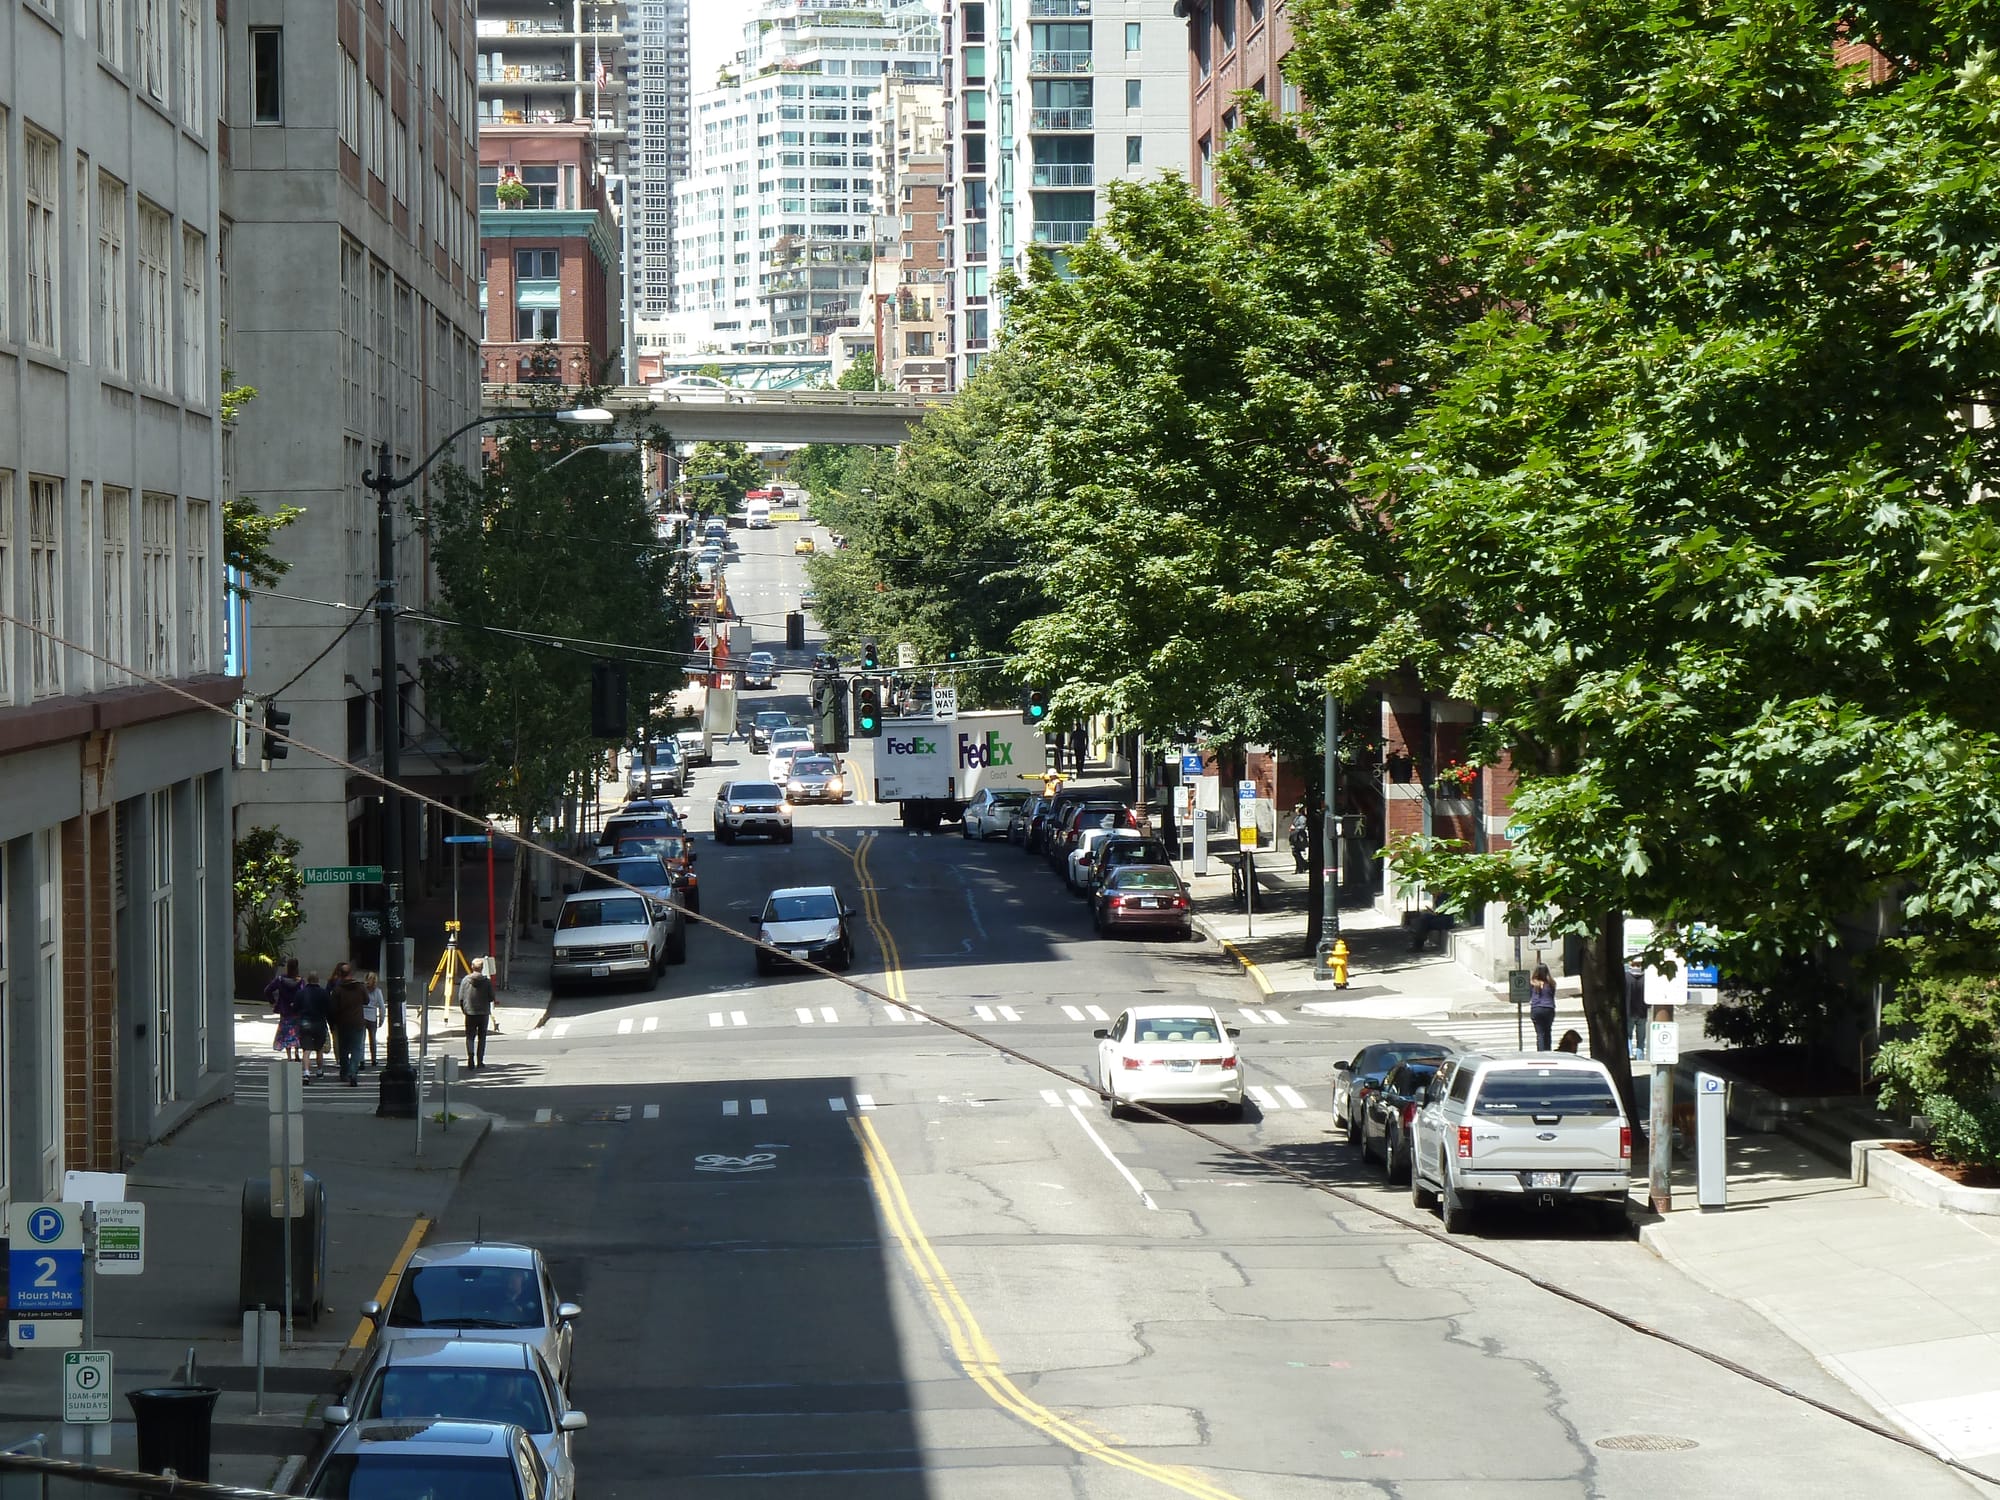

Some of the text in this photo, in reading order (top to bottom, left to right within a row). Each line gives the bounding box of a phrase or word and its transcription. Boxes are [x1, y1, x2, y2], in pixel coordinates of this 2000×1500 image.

[935, 690, 953, 698] ONE
[935, 700, 954, 708] WAY
[887, 737, 936, 754] FedEx
[958, 731, 1013, 769] FedEx
[1189, 757, 1196, 767] 2
[307, 868, 365, 882] Madison St
[1708, 1082, 1715, 1090] P
[120, 1208, 139, 1216] phone
[39, 1215, 55, 1236] P
[34, 1256, 57, 1287] 2
[18, 1291, 72, 1300] Hours Max
[70, 1354, 105, 1363] 2 HOUR
[84, 1371, 94, 1385] P
[68, 1392, 108, 1400] 10AM-6PM
